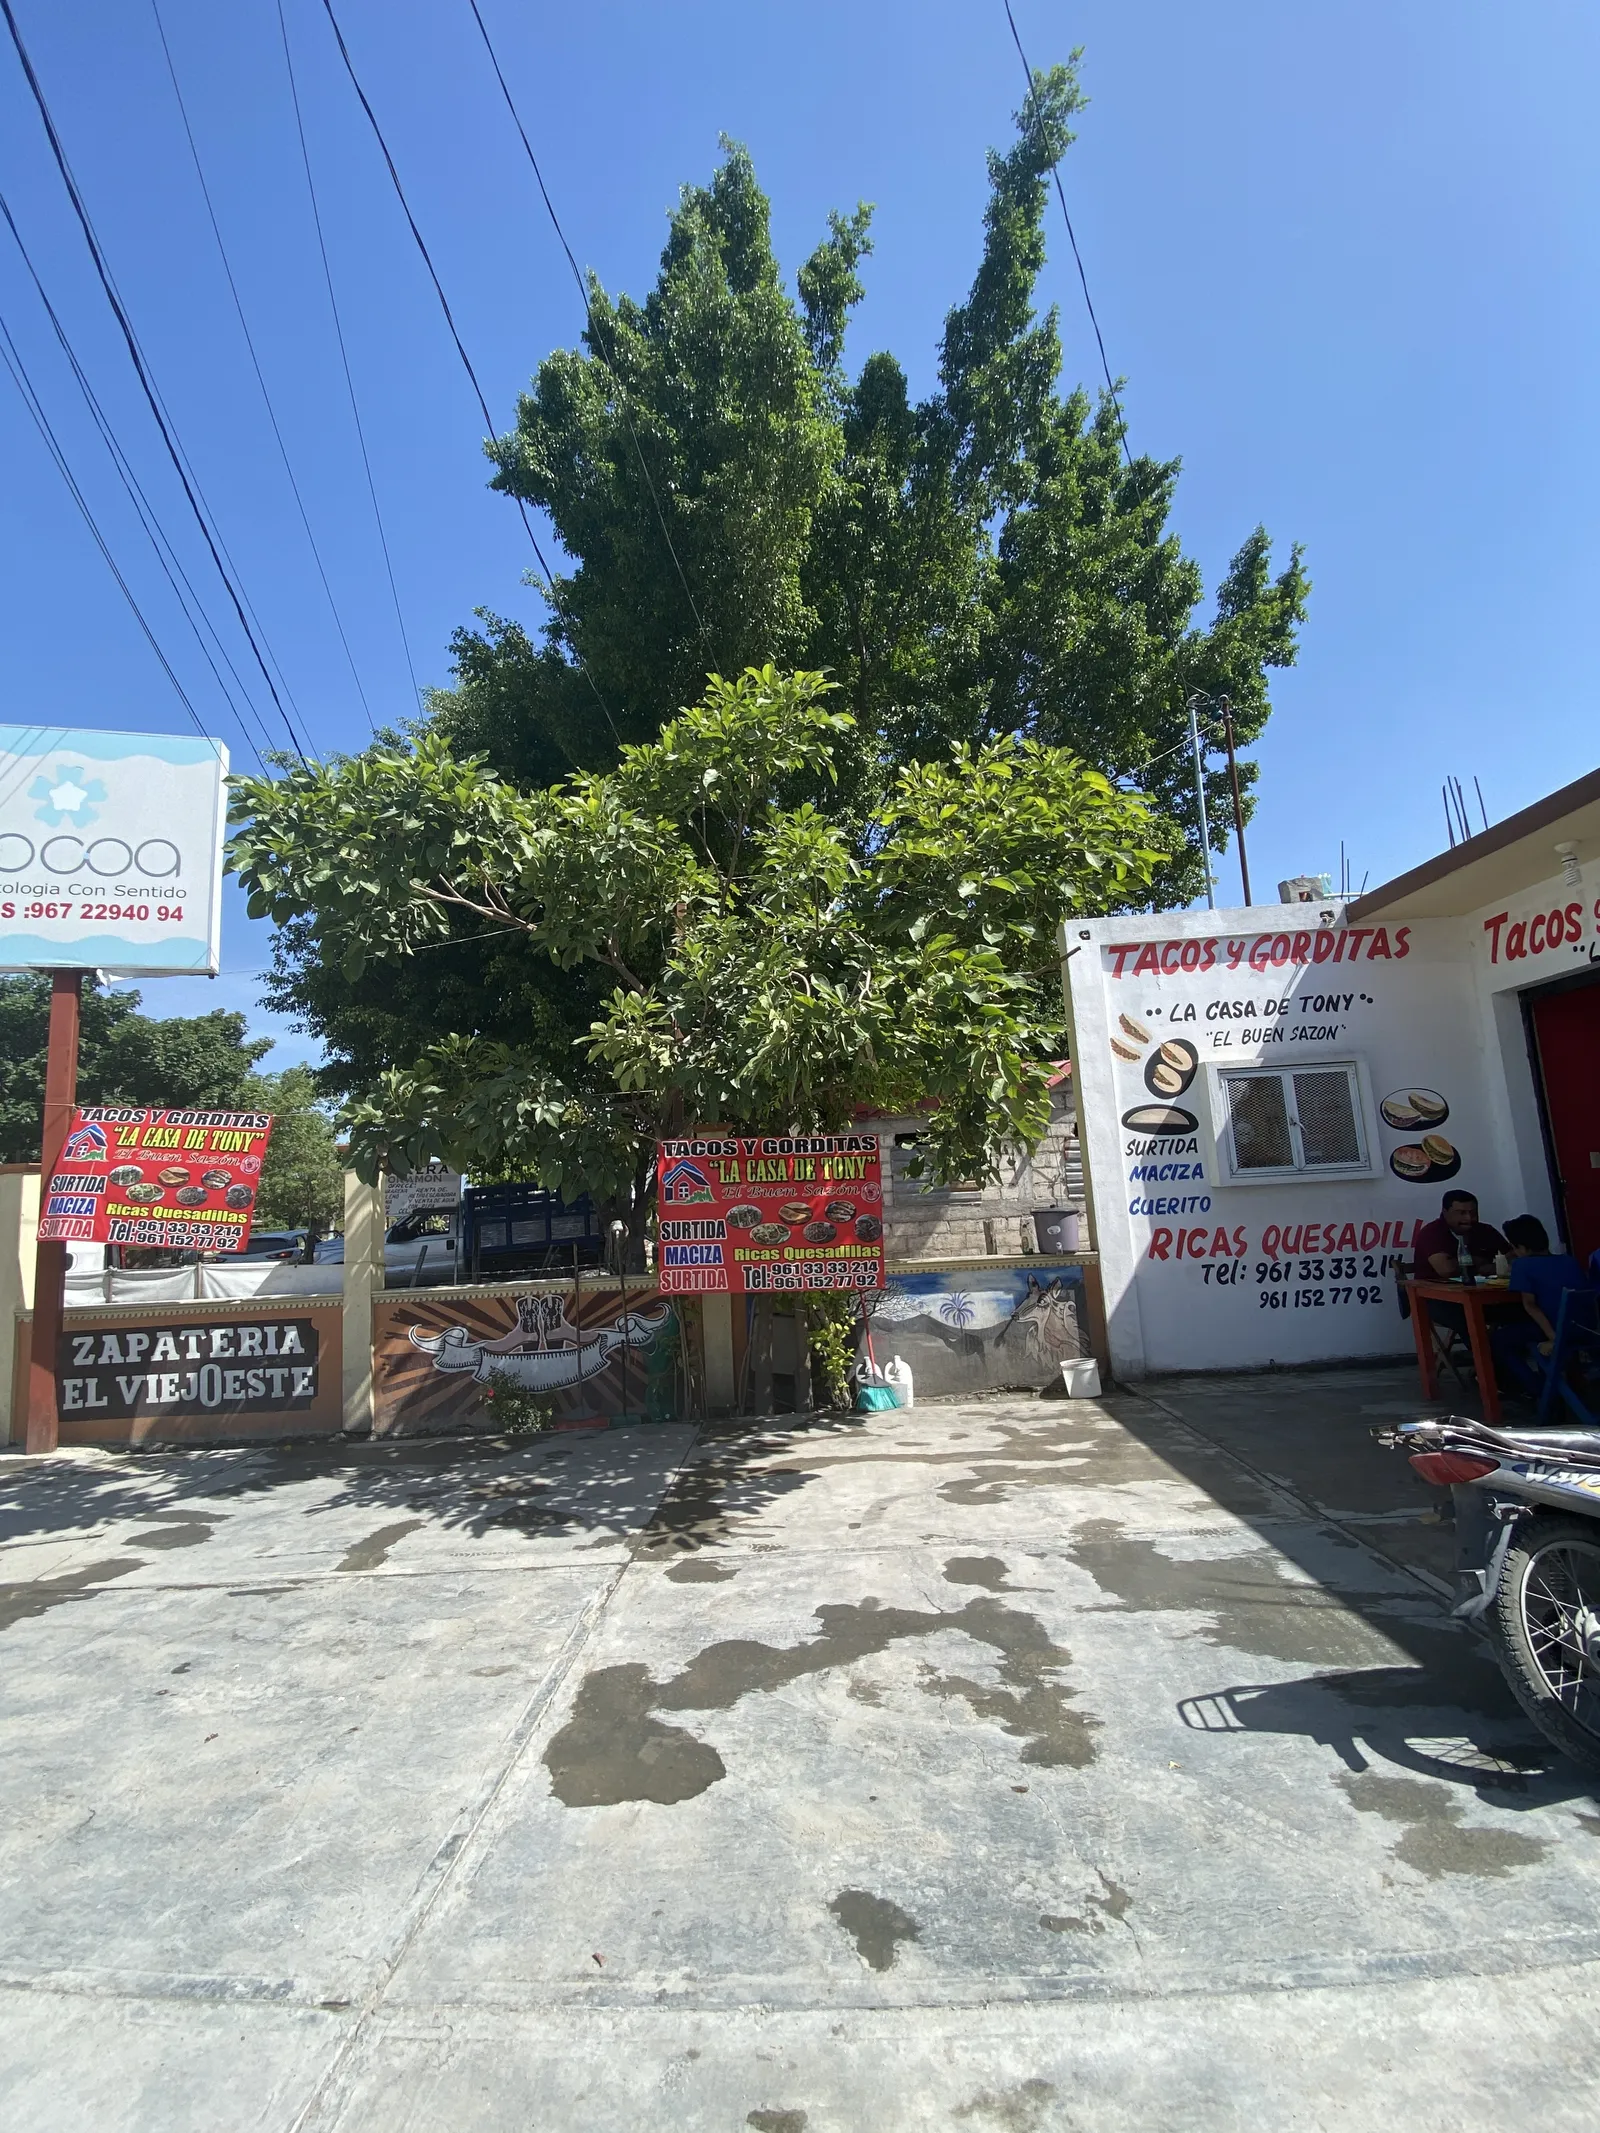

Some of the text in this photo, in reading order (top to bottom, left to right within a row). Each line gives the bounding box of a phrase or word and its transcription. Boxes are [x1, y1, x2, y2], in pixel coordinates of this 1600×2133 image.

[68, 883, 106, 896] Con
[114, 884, 187, 898] Sentido
[80, 903, 149, 921] 22940
[157, 905, 184, 922] 94
[1108, 938, 1220, 979] TACOS
[1250, 926, 1412, 973] GORDITAS
[1205, 1000, 1261, 1021] CASA
[1263, 998, 1290, 1016] DE
[1241, 1027, 1284, 1045] BUEN
[80, 1108, 271, 1129] TACOS Y GORDITAS
[141, 1127, 180, 1149] CASA
[182, 1129, 209, 1150] DE
[662, 1135, 878, 1158] TACOS Y GORDITAS
[1125, 1137, 1199, 1156] SURTIDA
[113, 1148, 241, 1167] El Buen Sazón
[746, 1158, 786, 1182] CASA
[793, 1157, 816, 1182] DE
[1129, 1162, 1204, 1182] MACIZA
[50, 1174, 108, 1194] SURTIDA
[721, 1182, 860, 1199] El Buen Sazón
[47, 1196, 97, 1216] MACIZA
[105, 1203, 248, 1224] Ricas Quesadillas
[1129, 1196, 1211, 1216] CUERITO
[38, 1217, 95, 1239] SURTIDA
[137, 1220, 165, 1232] 961
[167, 1222, 189, 1234] 33
[190, 1224, 212, 1235] 33
[214, 1225, 243, 1237] 214
[660, 1219, 727, 1241] SURTIDA
[137, 1233, 238, 1249] 961 152 77 92
[1149, 1225, 1248, 1261] RICAS
[664, 1244, 723, 1266] MACIZA
[734, 1245, 881, 1261] Ricas Quesadillas
[660, 1268, 728, 1291] SURTIDA
[743, 1260, 879, 1289] Tel: 961 33 33 214
[1255, 1261, 1291, 1284] 961
[1299, 1259, 1325, 1281] 33
[1329, 1256, 1357, 1280] 33
[774, 1274, 878, 1289] 961 152 77 92
[1259, 1285, 1383, 1309] 961 152 77 92
[71, 1325, 305, 1366] ZAPATERIA
[62, 1377, 108, 1410] EL
[1526, 1463, 1600, 1487] Wave
